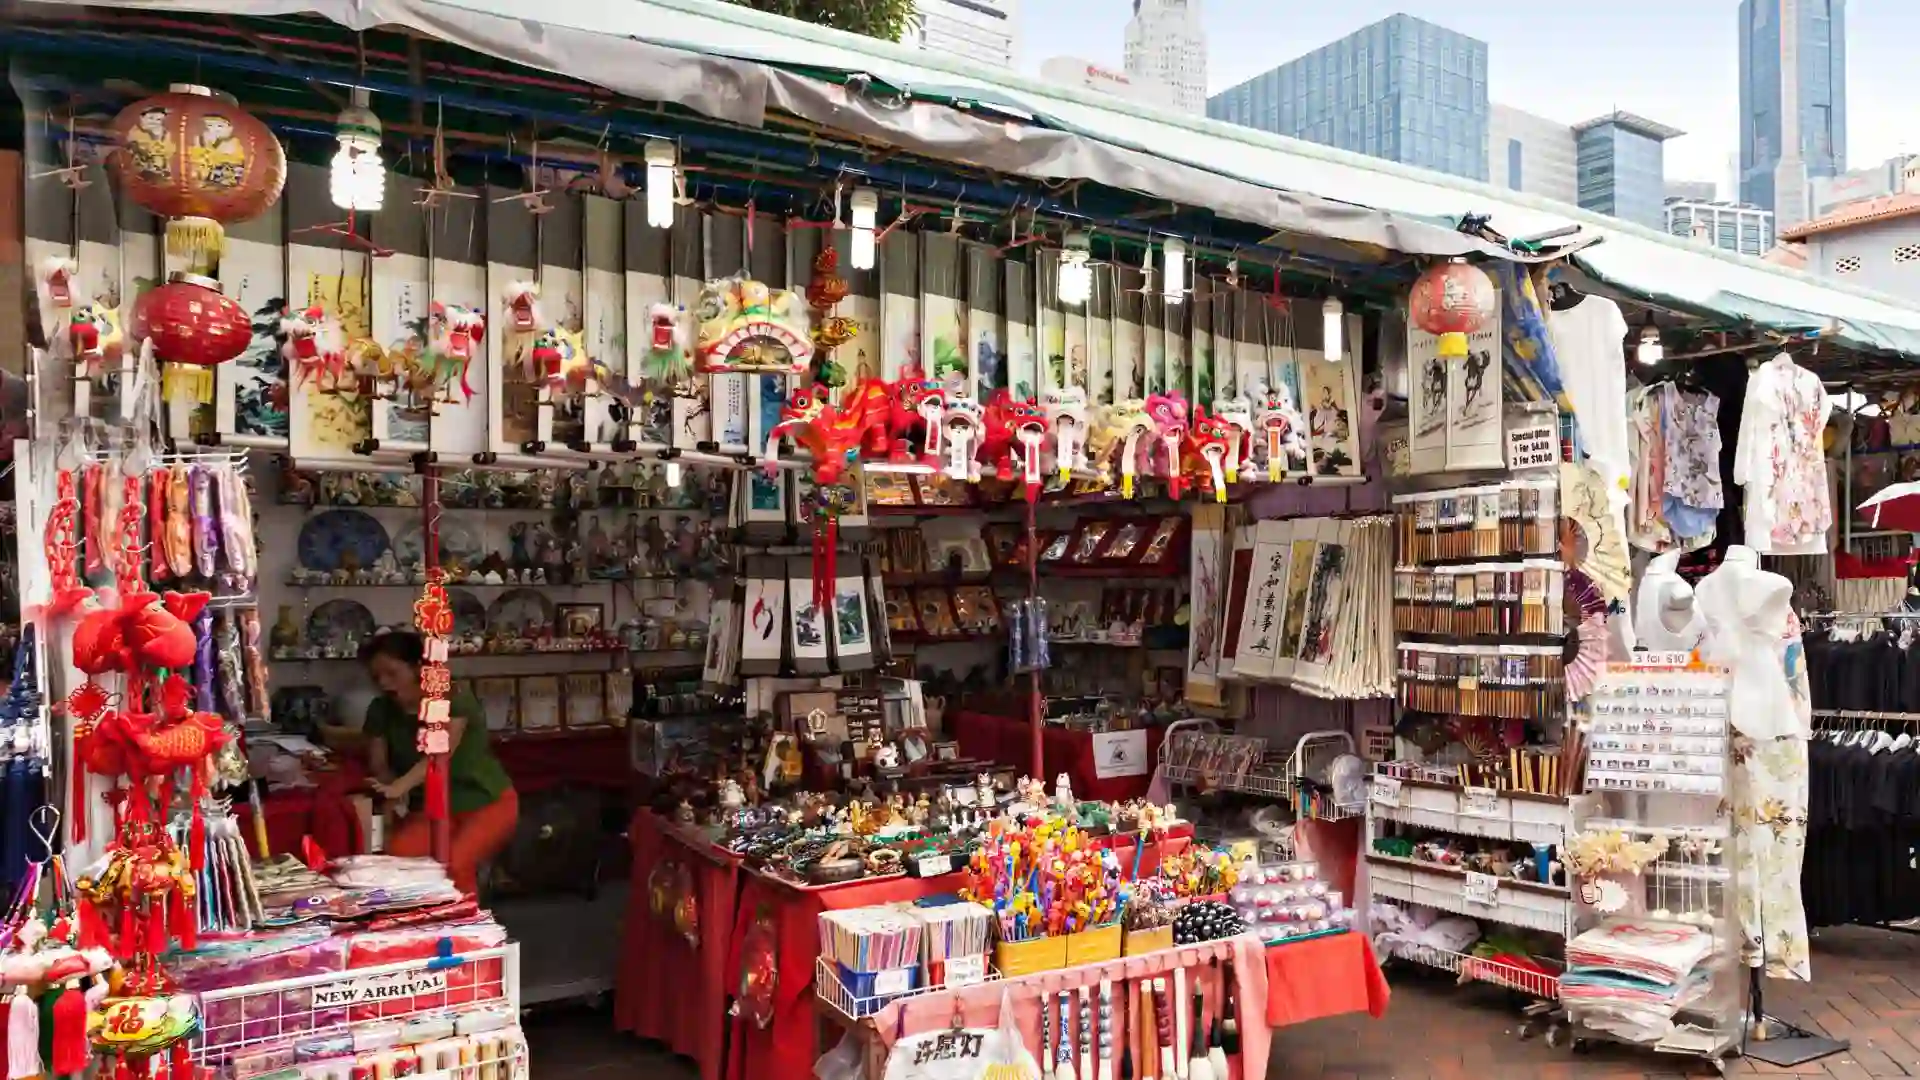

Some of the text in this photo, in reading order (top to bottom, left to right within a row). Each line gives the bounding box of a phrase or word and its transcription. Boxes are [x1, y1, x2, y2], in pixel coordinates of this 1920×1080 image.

[1511, 430, 1534, 441] Special
[1531, 453, 1553, 464] $10.00
[1635, 654, 1642, 663] 3
[1666, 653, 1685, 664] $10
[314, 976, 443, 1004] NEW ARRIVAL
